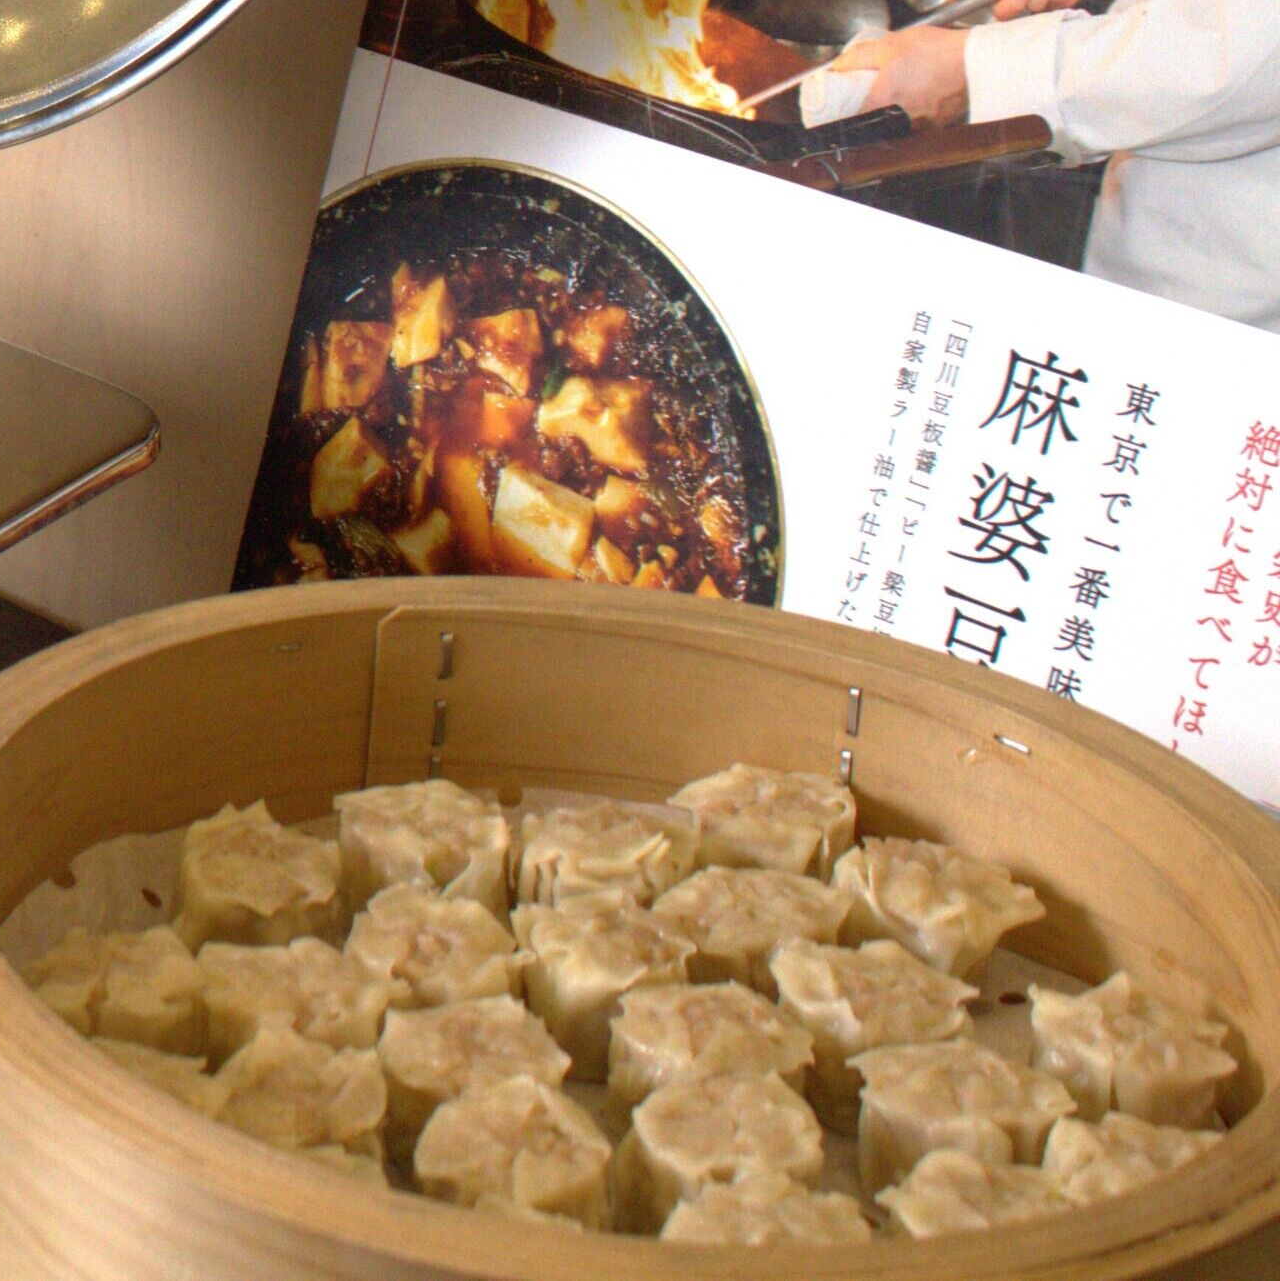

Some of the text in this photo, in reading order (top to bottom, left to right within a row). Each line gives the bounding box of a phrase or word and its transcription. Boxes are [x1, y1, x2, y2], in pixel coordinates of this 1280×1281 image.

[836, 310, 933, 623] 自家製ラー油で仕上げた
[1046, 382, 1162, 702] 東京で一番美味
[1171, 419, 1280, 752] 絶対に食べてほ
